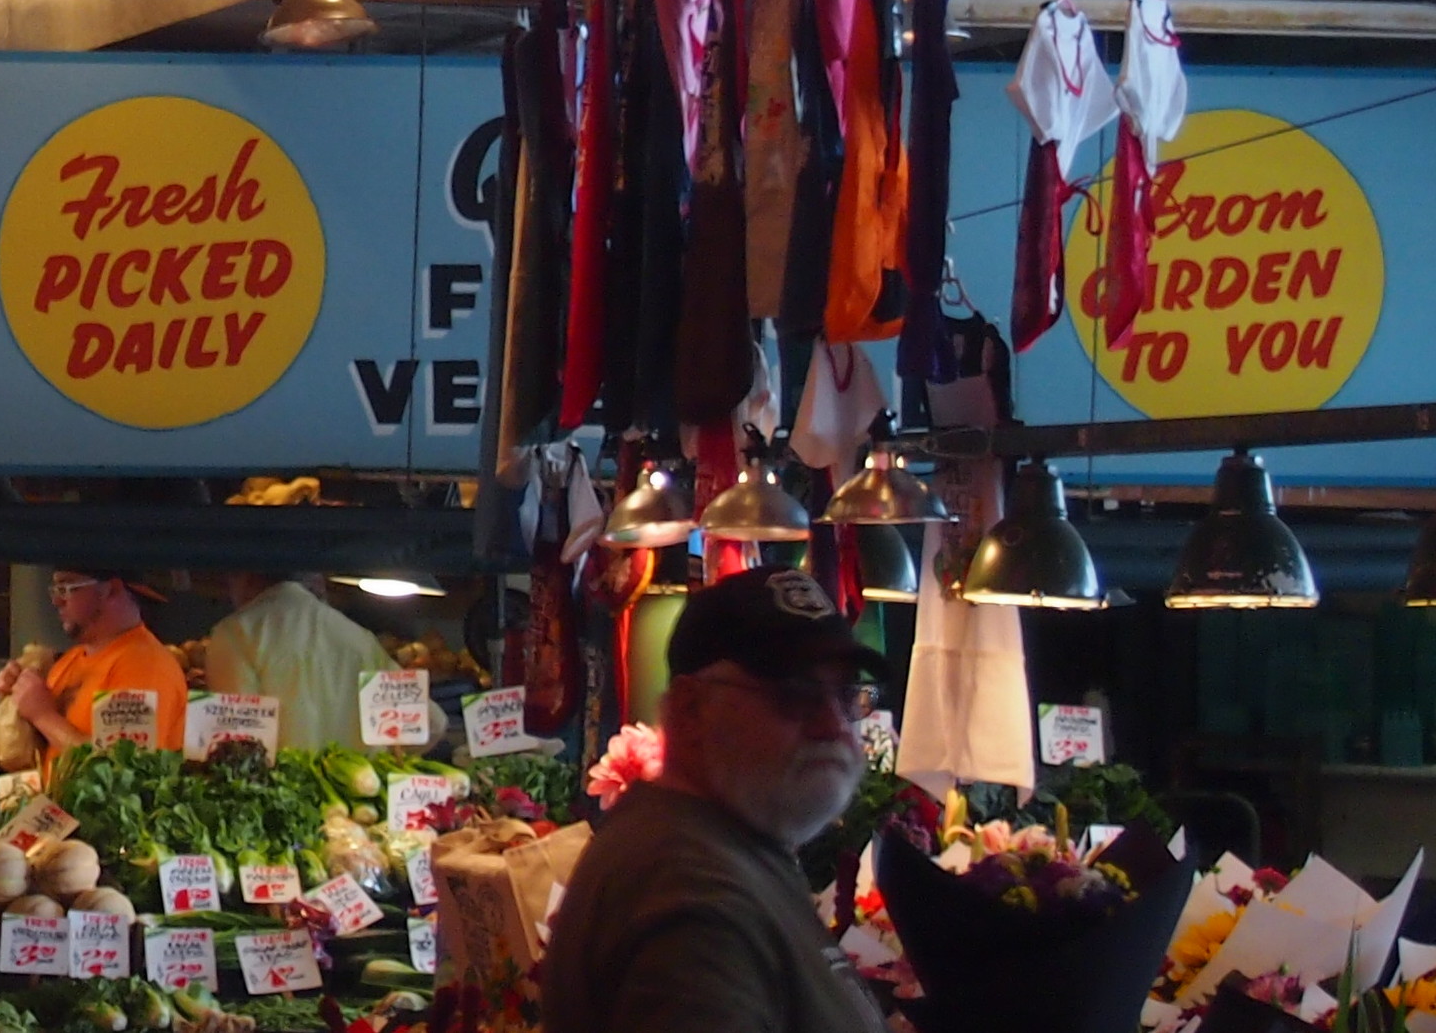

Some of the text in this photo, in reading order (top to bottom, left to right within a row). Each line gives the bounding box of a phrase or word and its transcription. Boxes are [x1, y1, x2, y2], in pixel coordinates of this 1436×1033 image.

[60, 138, 267, 241] Fresh
[33, 239, 293, 314] PICKED
[66, 312, 267, 379] DAILY
[1121, 317, 1344, 383] TO YOU
